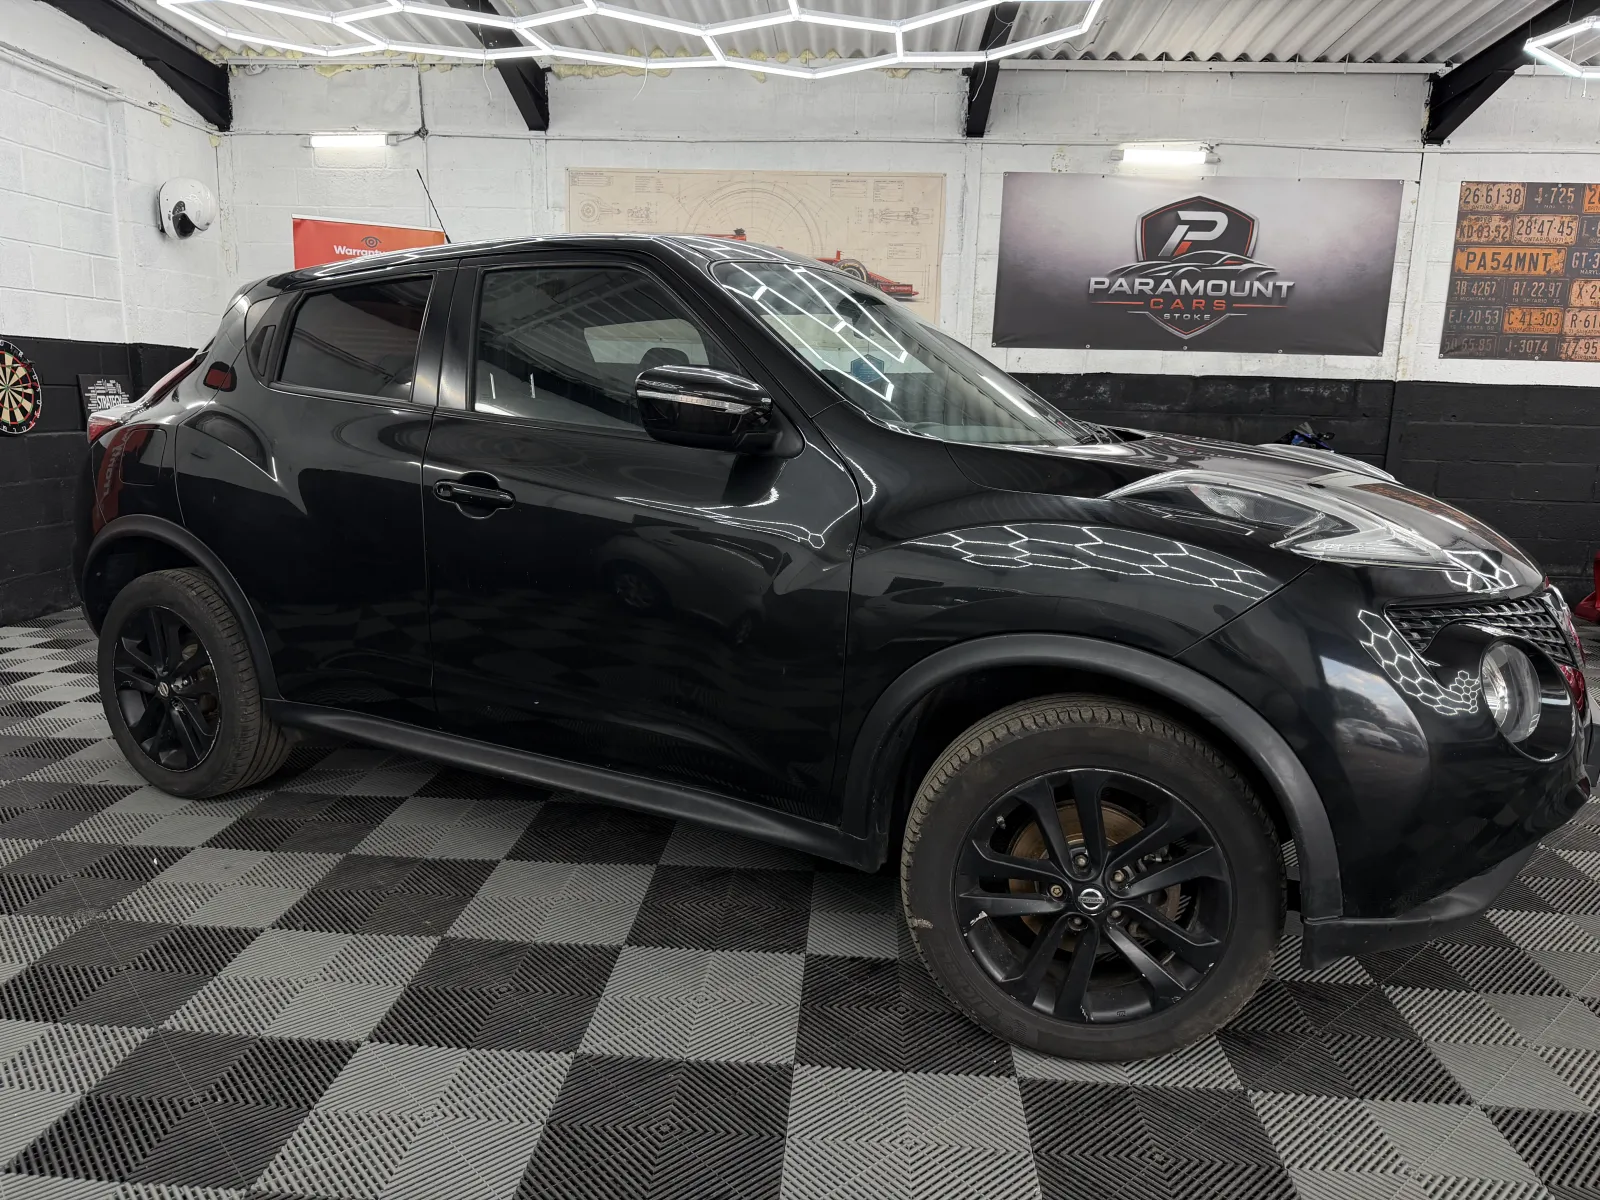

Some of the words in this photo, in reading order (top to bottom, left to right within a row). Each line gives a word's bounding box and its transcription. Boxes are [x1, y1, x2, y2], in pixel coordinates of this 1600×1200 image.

[1465, 251, 1552, 272] PA54MNT
[1088, 277, 1295, 298] PARAMOUNT
[1149, 298, 1227, 310] CARS
[1163, 312, 1212, 321] STOKE
